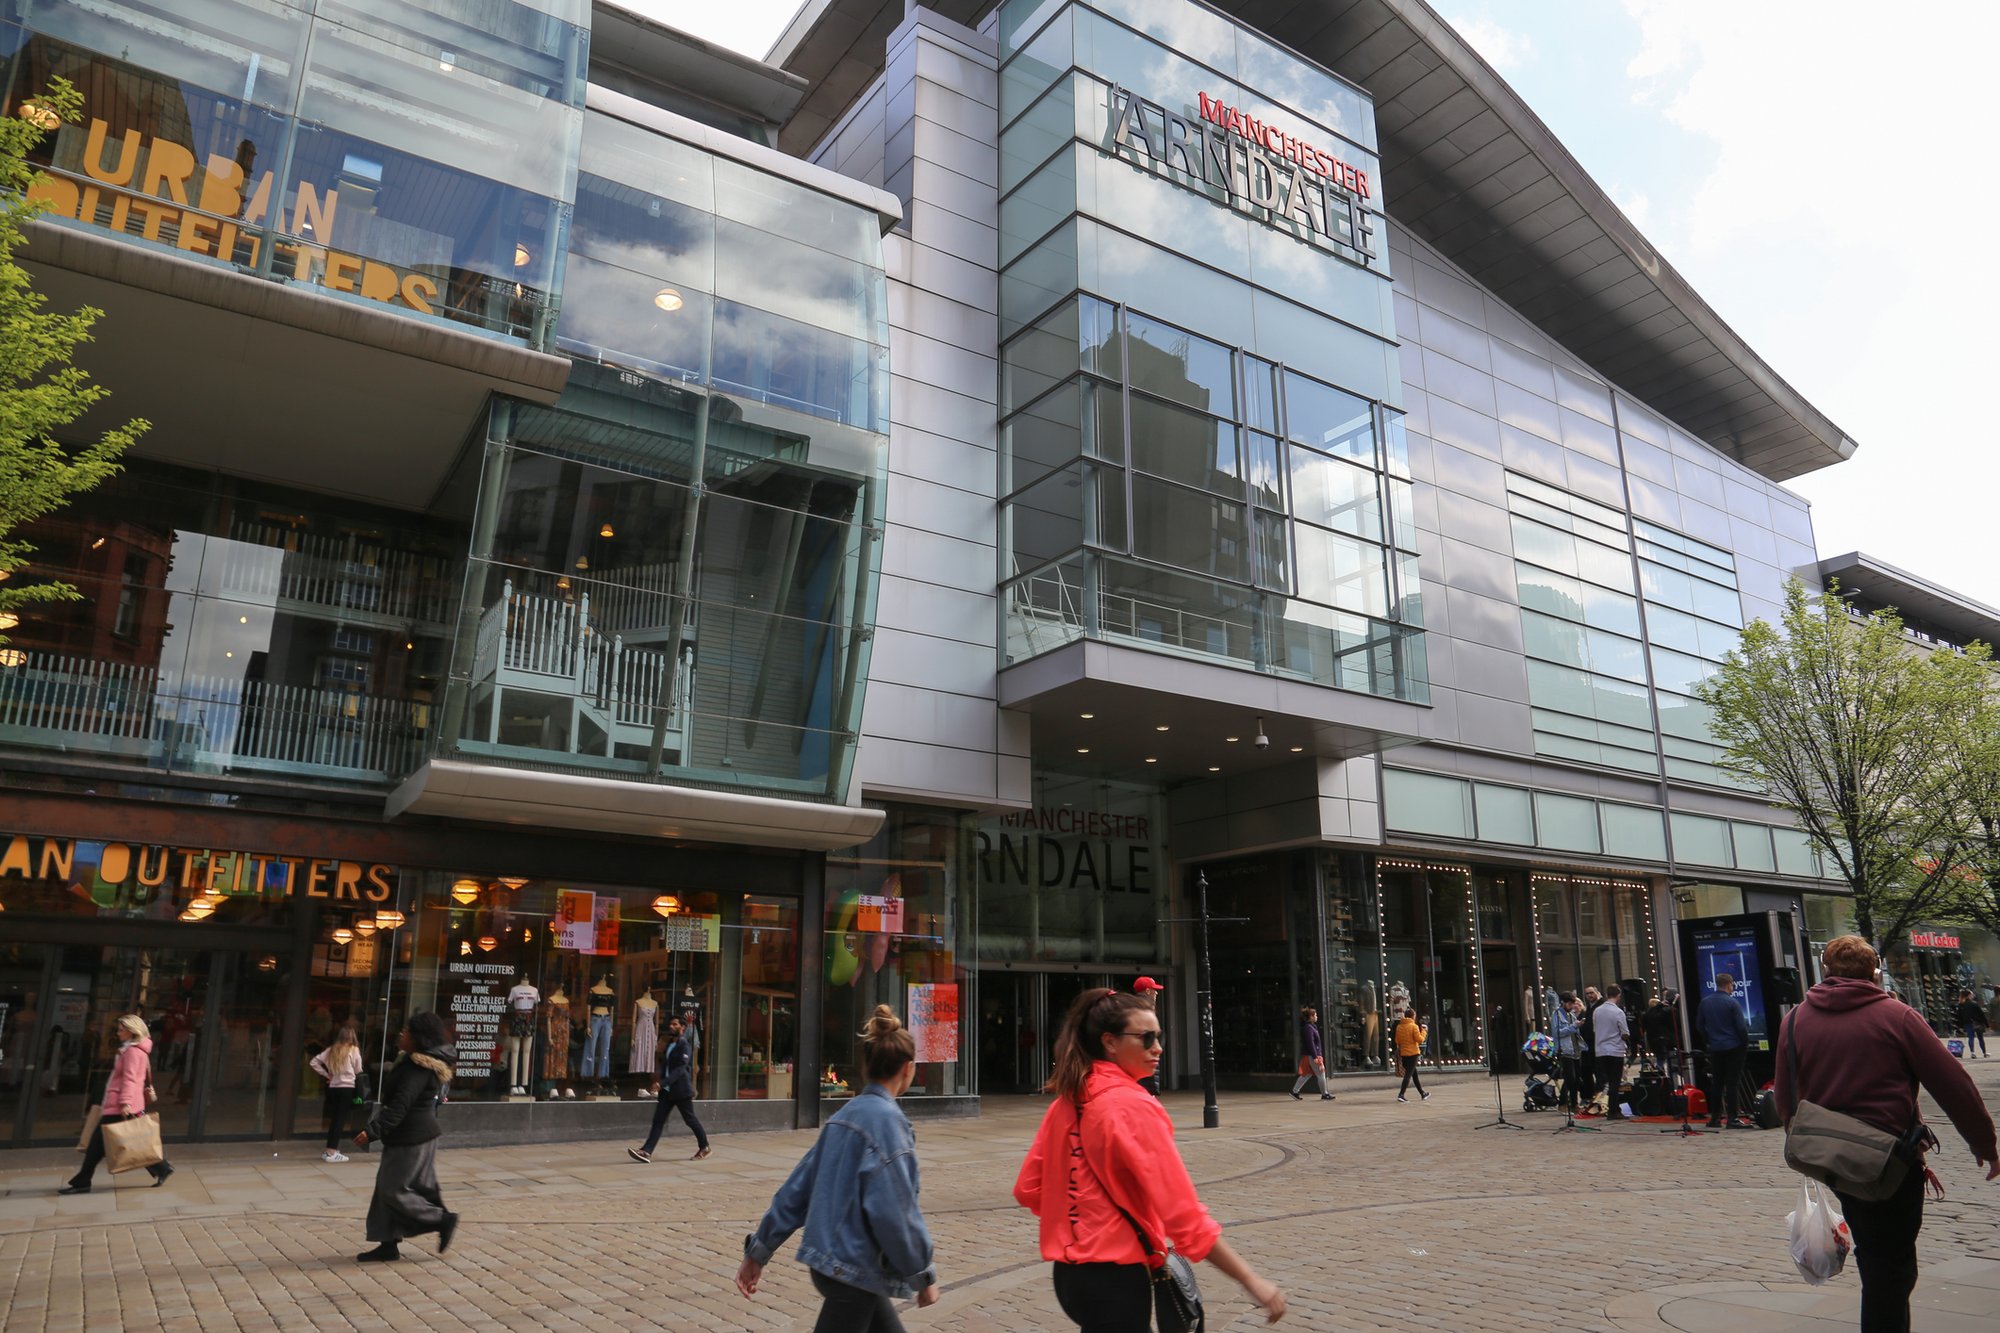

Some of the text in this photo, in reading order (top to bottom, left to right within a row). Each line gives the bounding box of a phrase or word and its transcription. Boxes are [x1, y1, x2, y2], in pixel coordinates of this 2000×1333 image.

[1199, 91, 1370, 198] MANCHESTER
[1115, 91, 1376, 259] ARNDALE
[83, 118, 337, 246] URBAN
[1000, 807, 1149, 840] MANCHESTER
[967, 831, 1150, 893] RNDALE
[100, 843, 392, 901] OUTFITTERS
[1911, 929, 1960, 949] Foot Locker
[450, 962, 515, 975] URBAN OUTFITTERS
[471, 985, 490, 995] HOME
[453, 994, 506, 1005] CLICK & COLLECT
[450, 1003, 507, 1013] COLLECTION POINT
[456, 1013, 500, 1023] WOMENSWEAR
[455, 1023, 499, 1033] MUSIC & TECH
[455, 1040, 496, 1050] ACCESSORIES
[459, 1051, 491, 1060] INTIMATES
[456, 1068, 491, 1077] MENSWEAR
